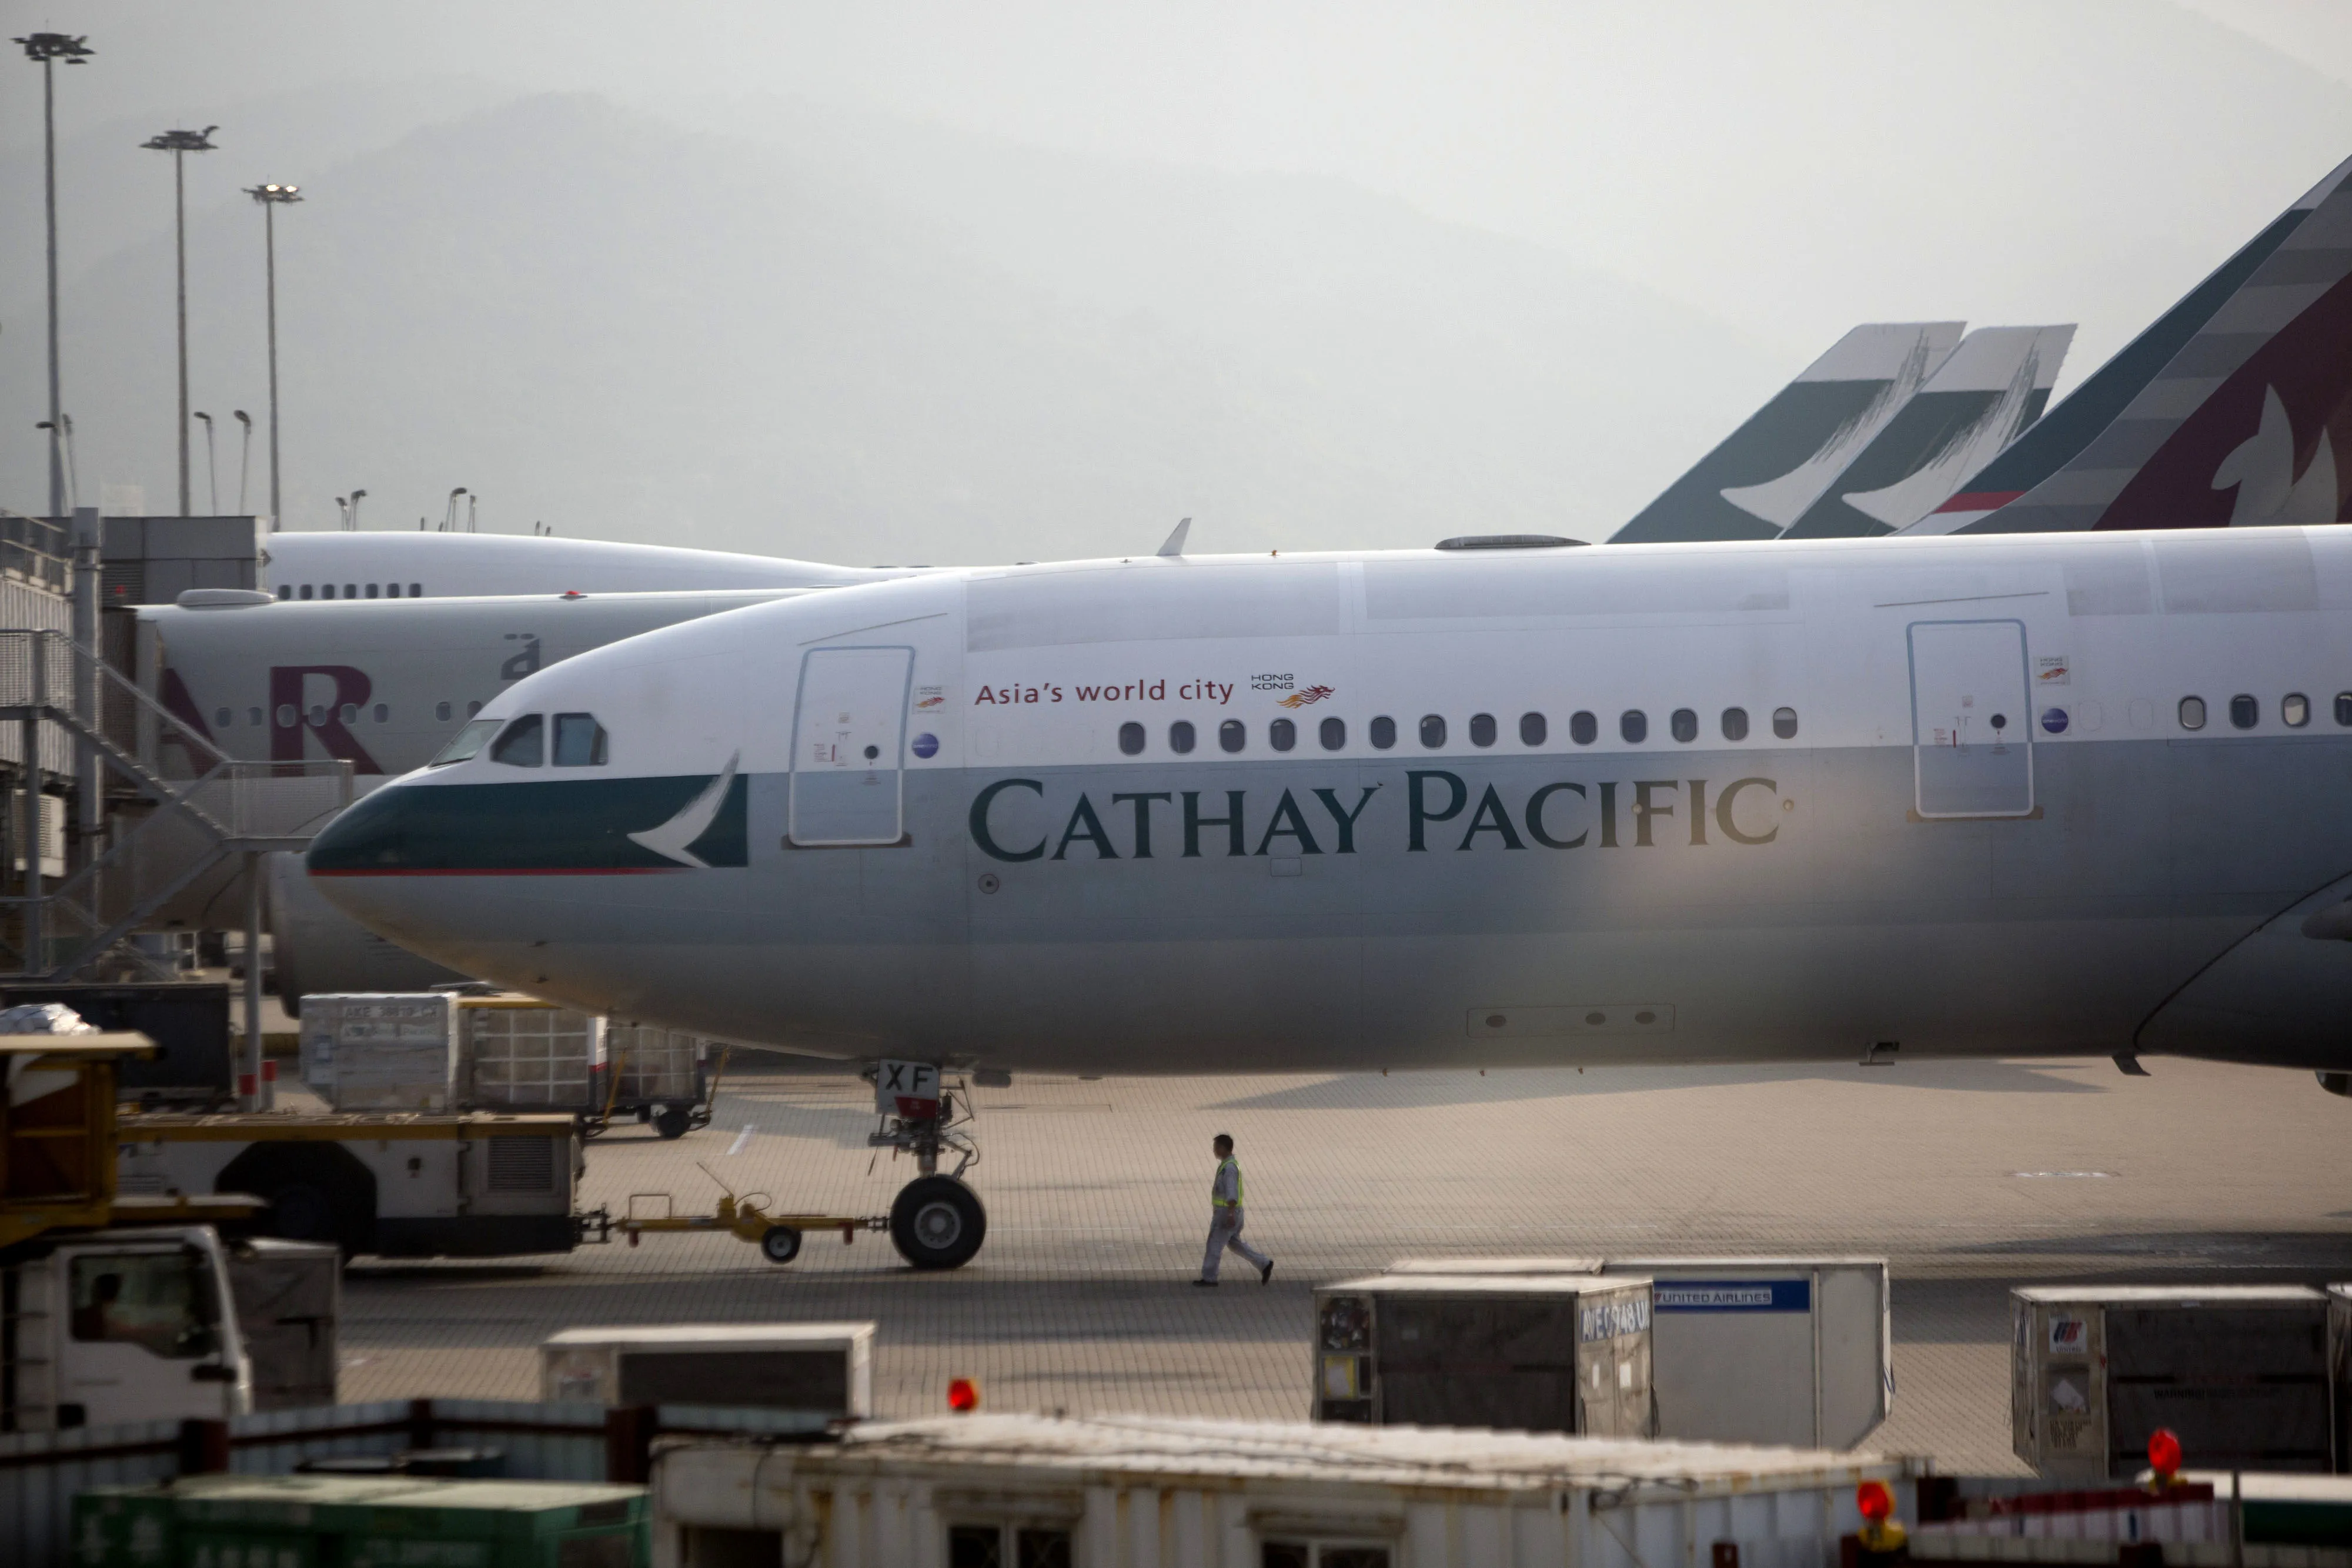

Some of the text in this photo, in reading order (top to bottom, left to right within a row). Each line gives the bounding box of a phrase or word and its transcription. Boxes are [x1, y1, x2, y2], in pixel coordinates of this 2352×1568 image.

[974, 678, 1234, 705] Asia's world city
[1251, 682, 1294, 690] KONG
[968, 770, 1780, 863] CATHAY PACIFIC
[885, 1064, 933, 1092] XF
[1662, 1291, 1771, 1303] UNITED AIRLINES
